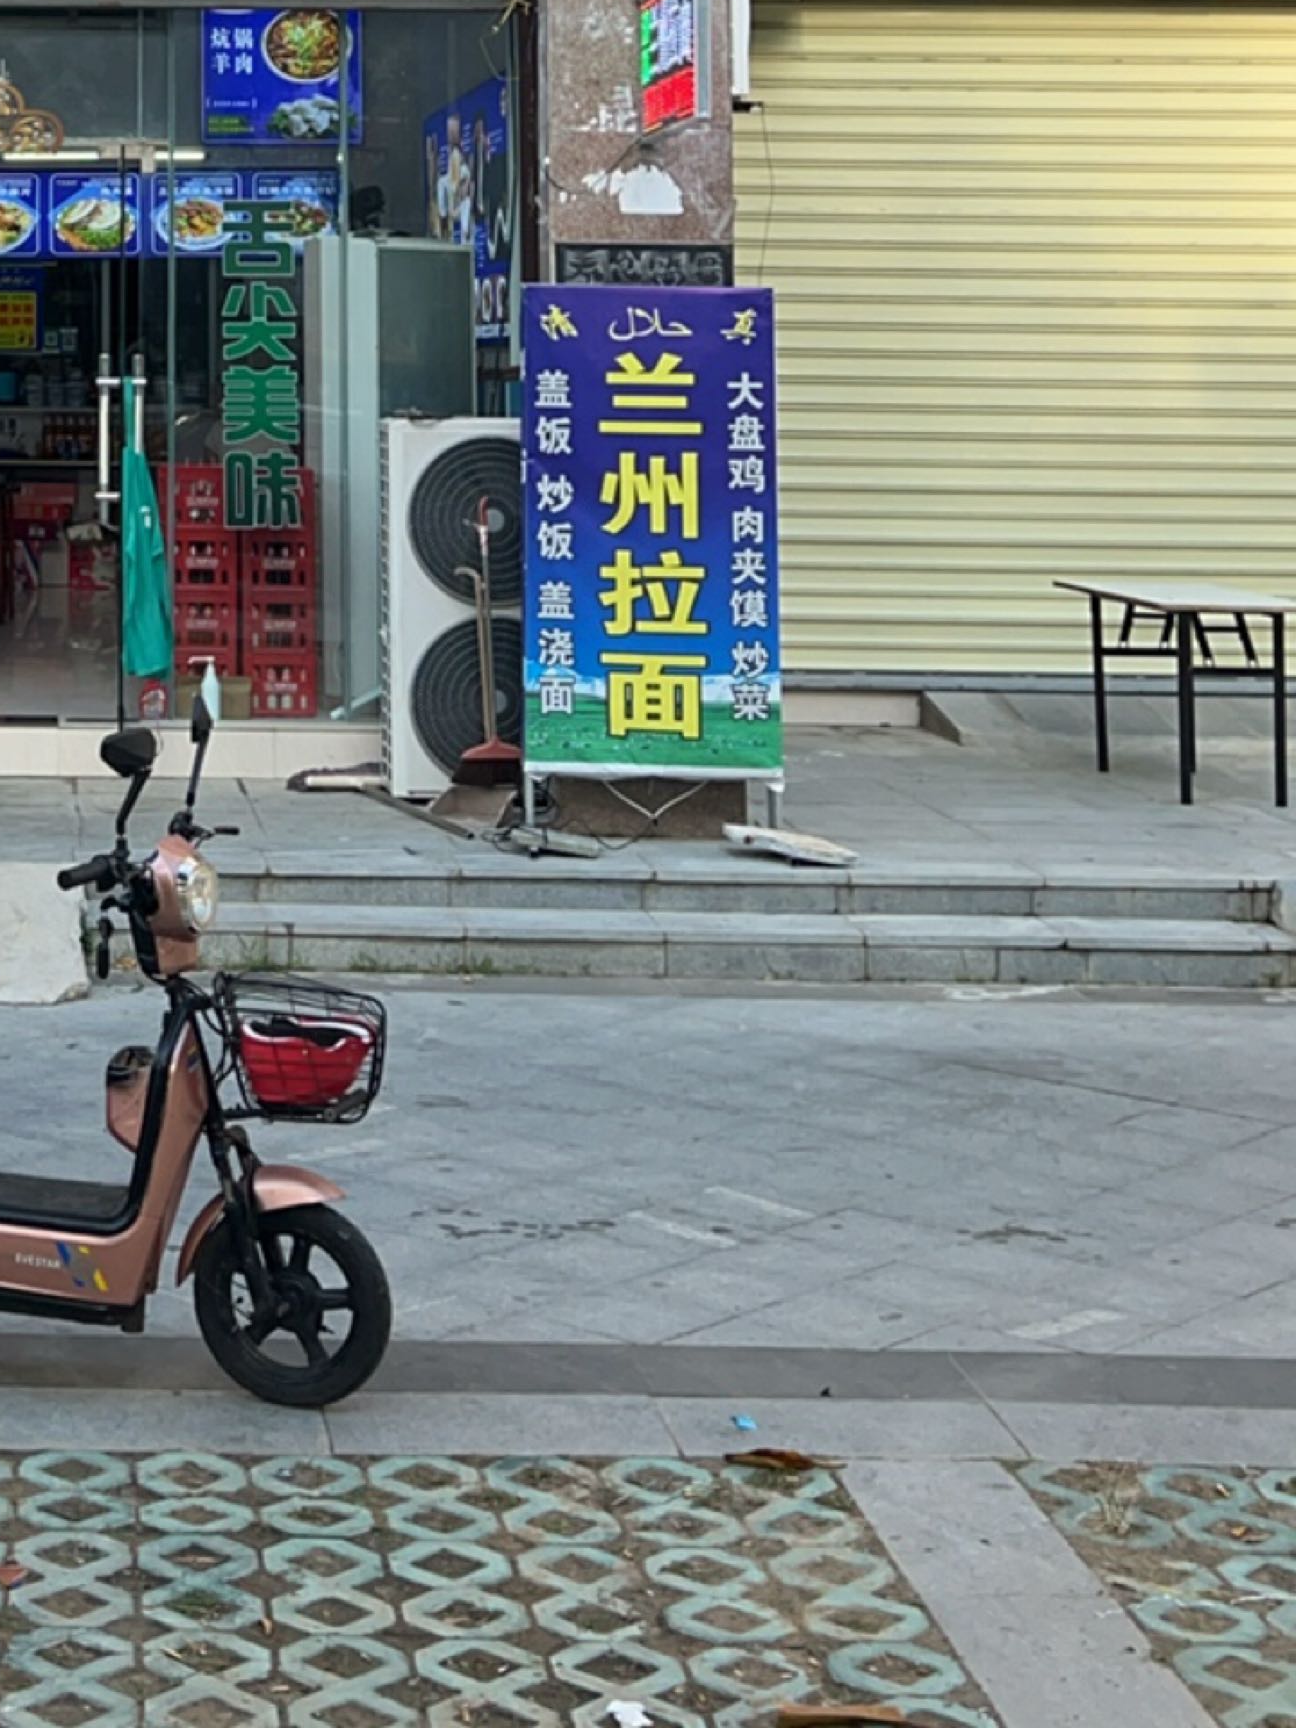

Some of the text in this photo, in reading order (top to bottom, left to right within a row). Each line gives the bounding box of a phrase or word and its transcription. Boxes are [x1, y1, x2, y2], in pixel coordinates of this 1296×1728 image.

[221, 200, 300, 531] 舌尖美味
[609, 307, 693, 341] حلال
[534, 370, 576, 714] 盖饭 炒饭 盖浇面
[598, 351, 709, 741] 兰州拉面
[727, 372, 771, 721] 大盘鸡 肉夹馍 炒菜
